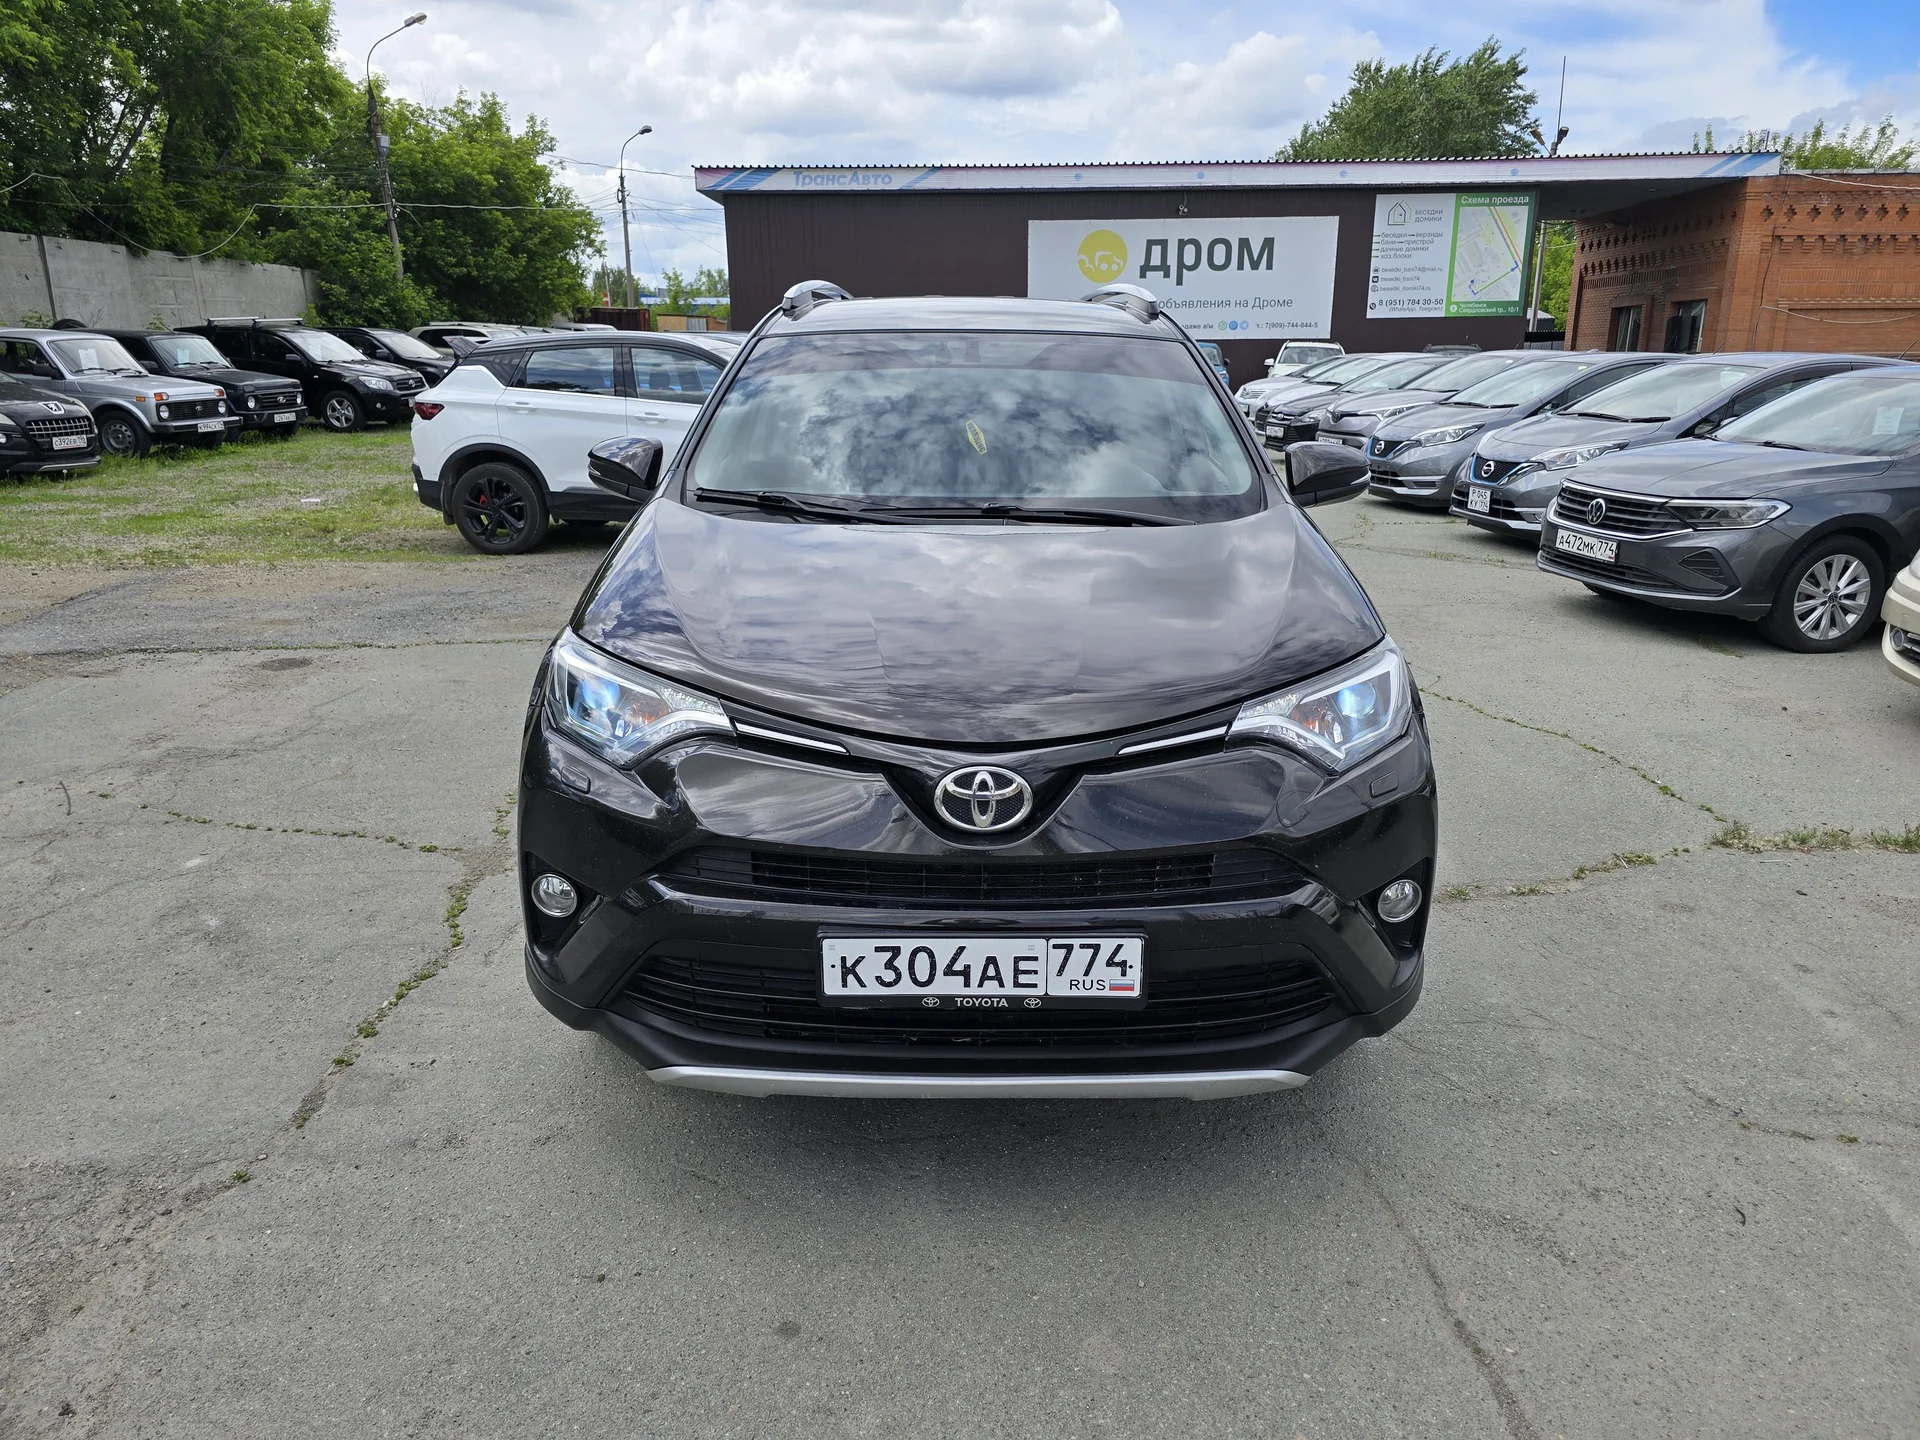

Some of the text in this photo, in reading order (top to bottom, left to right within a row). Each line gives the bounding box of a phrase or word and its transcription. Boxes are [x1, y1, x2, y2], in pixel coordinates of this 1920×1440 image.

[793, 170, 893, 187] ТрансАвто
[1461, 196, 1529, 206] Схема проезда
[1403, 238, 1435, 246] пристрой
[1139, 236, 1276, 287] дром
[1158, 296, 1293, 310] объявления на Дроме
[1385, 299, 1405, 307] (951)
[1422, 298, 1444, 306] 30-50
[1558, 533, 1614, 556] А472МК 774
[840, 943, 1129, 989] К304АЕ 774
[1069, 979, 1106, 992] RUS
[955, 997, 1009, 1008] TOYOTA
